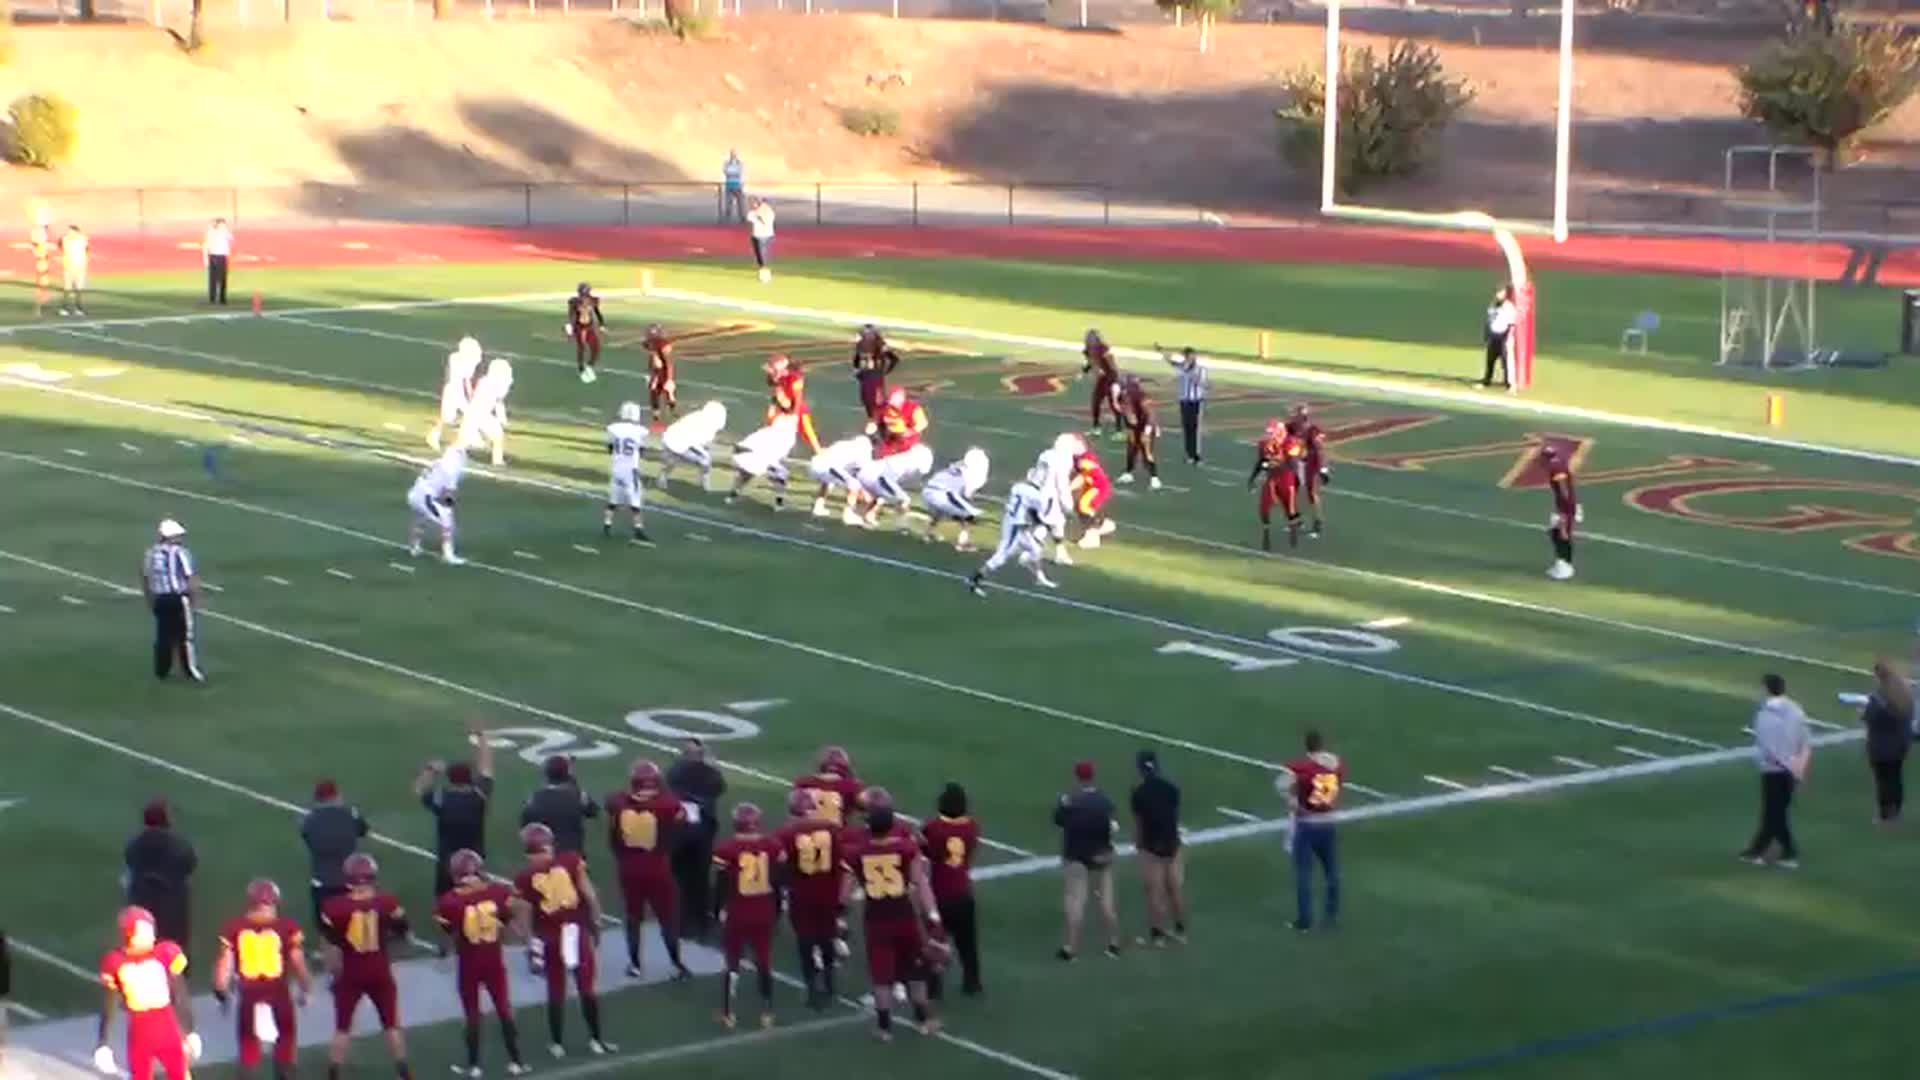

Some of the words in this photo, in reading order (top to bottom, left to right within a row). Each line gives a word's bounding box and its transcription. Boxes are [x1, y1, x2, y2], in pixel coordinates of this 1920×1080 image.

[1156, 625, 1401, 671] 10
[467, 708, 761, 765] 20
[738, 850, 769, 896] 21
[860, 853, 905, 898] 55
